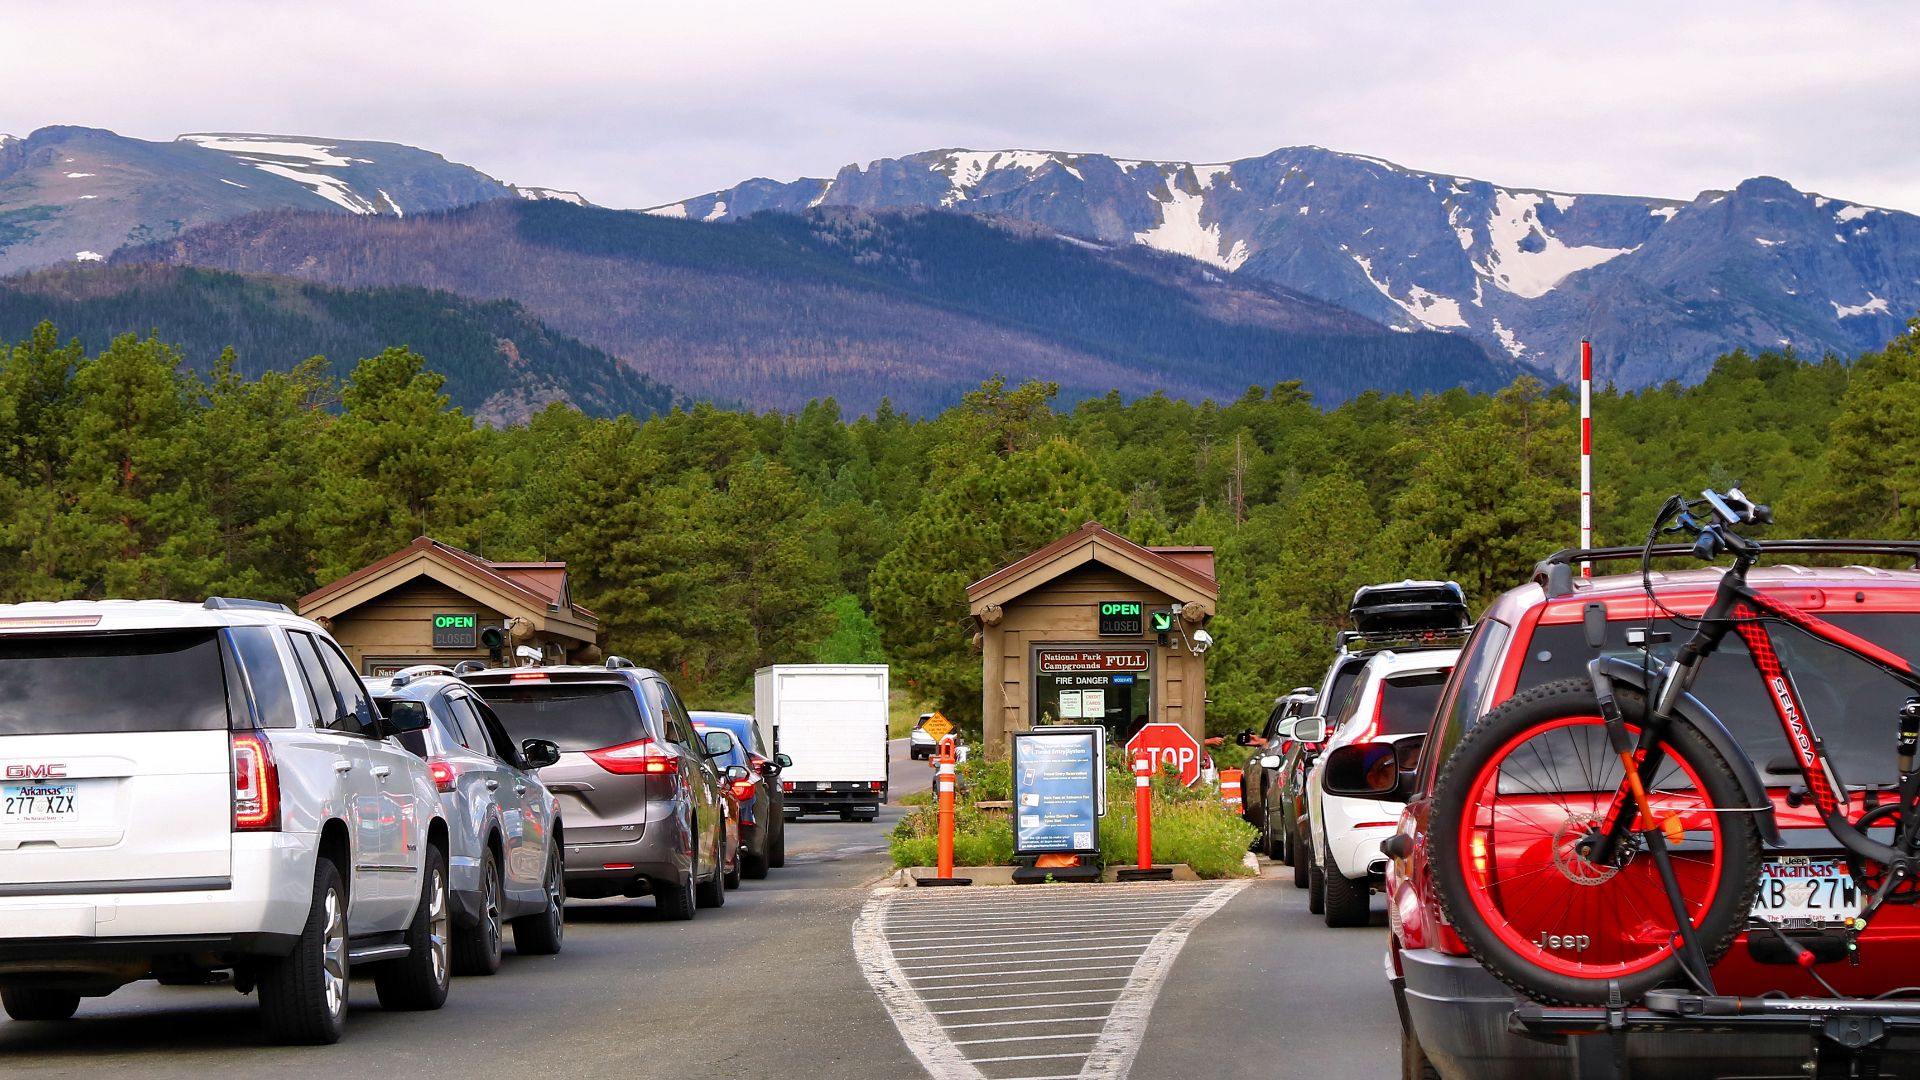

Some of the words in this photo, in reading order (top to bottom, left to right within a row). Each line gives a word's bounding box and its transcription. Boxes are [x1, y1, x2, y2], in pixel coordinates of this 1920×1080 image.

[1102, 604, 1140, 615] OPEN
[435, 616, 473, 628] OPEN
[1102, 620, 1139, 632] CLOSED
[436, 633, 472, 645] CLOSED
[1044, 653, 1078, 661] National
[1082, 653, 1102, 661] Park
[1044, 662, 1101, 671] Campgrounds
[1105, 655, 1146, 667] FULL
[1055, 676, 1073, 685] FIRE
[1076, 676, 1109, 685] DANGER
[1772, 677, 1815, 767] SENADA
[1131, 747, 1194, 774] TOP
[6, 764, 67, 778] GMC
[20, 786, 61, 796] Arkansas
[1601, 748, 1649, 836] SENAA
[6, 796, 35, 814] 277
[46, 795, 74, 813] XZX
[1785, 857, 1807, 866] Jeep
[1761, 864, 1834, 878] Arkansas
[1532, 931, 1591, 953] Jeep
